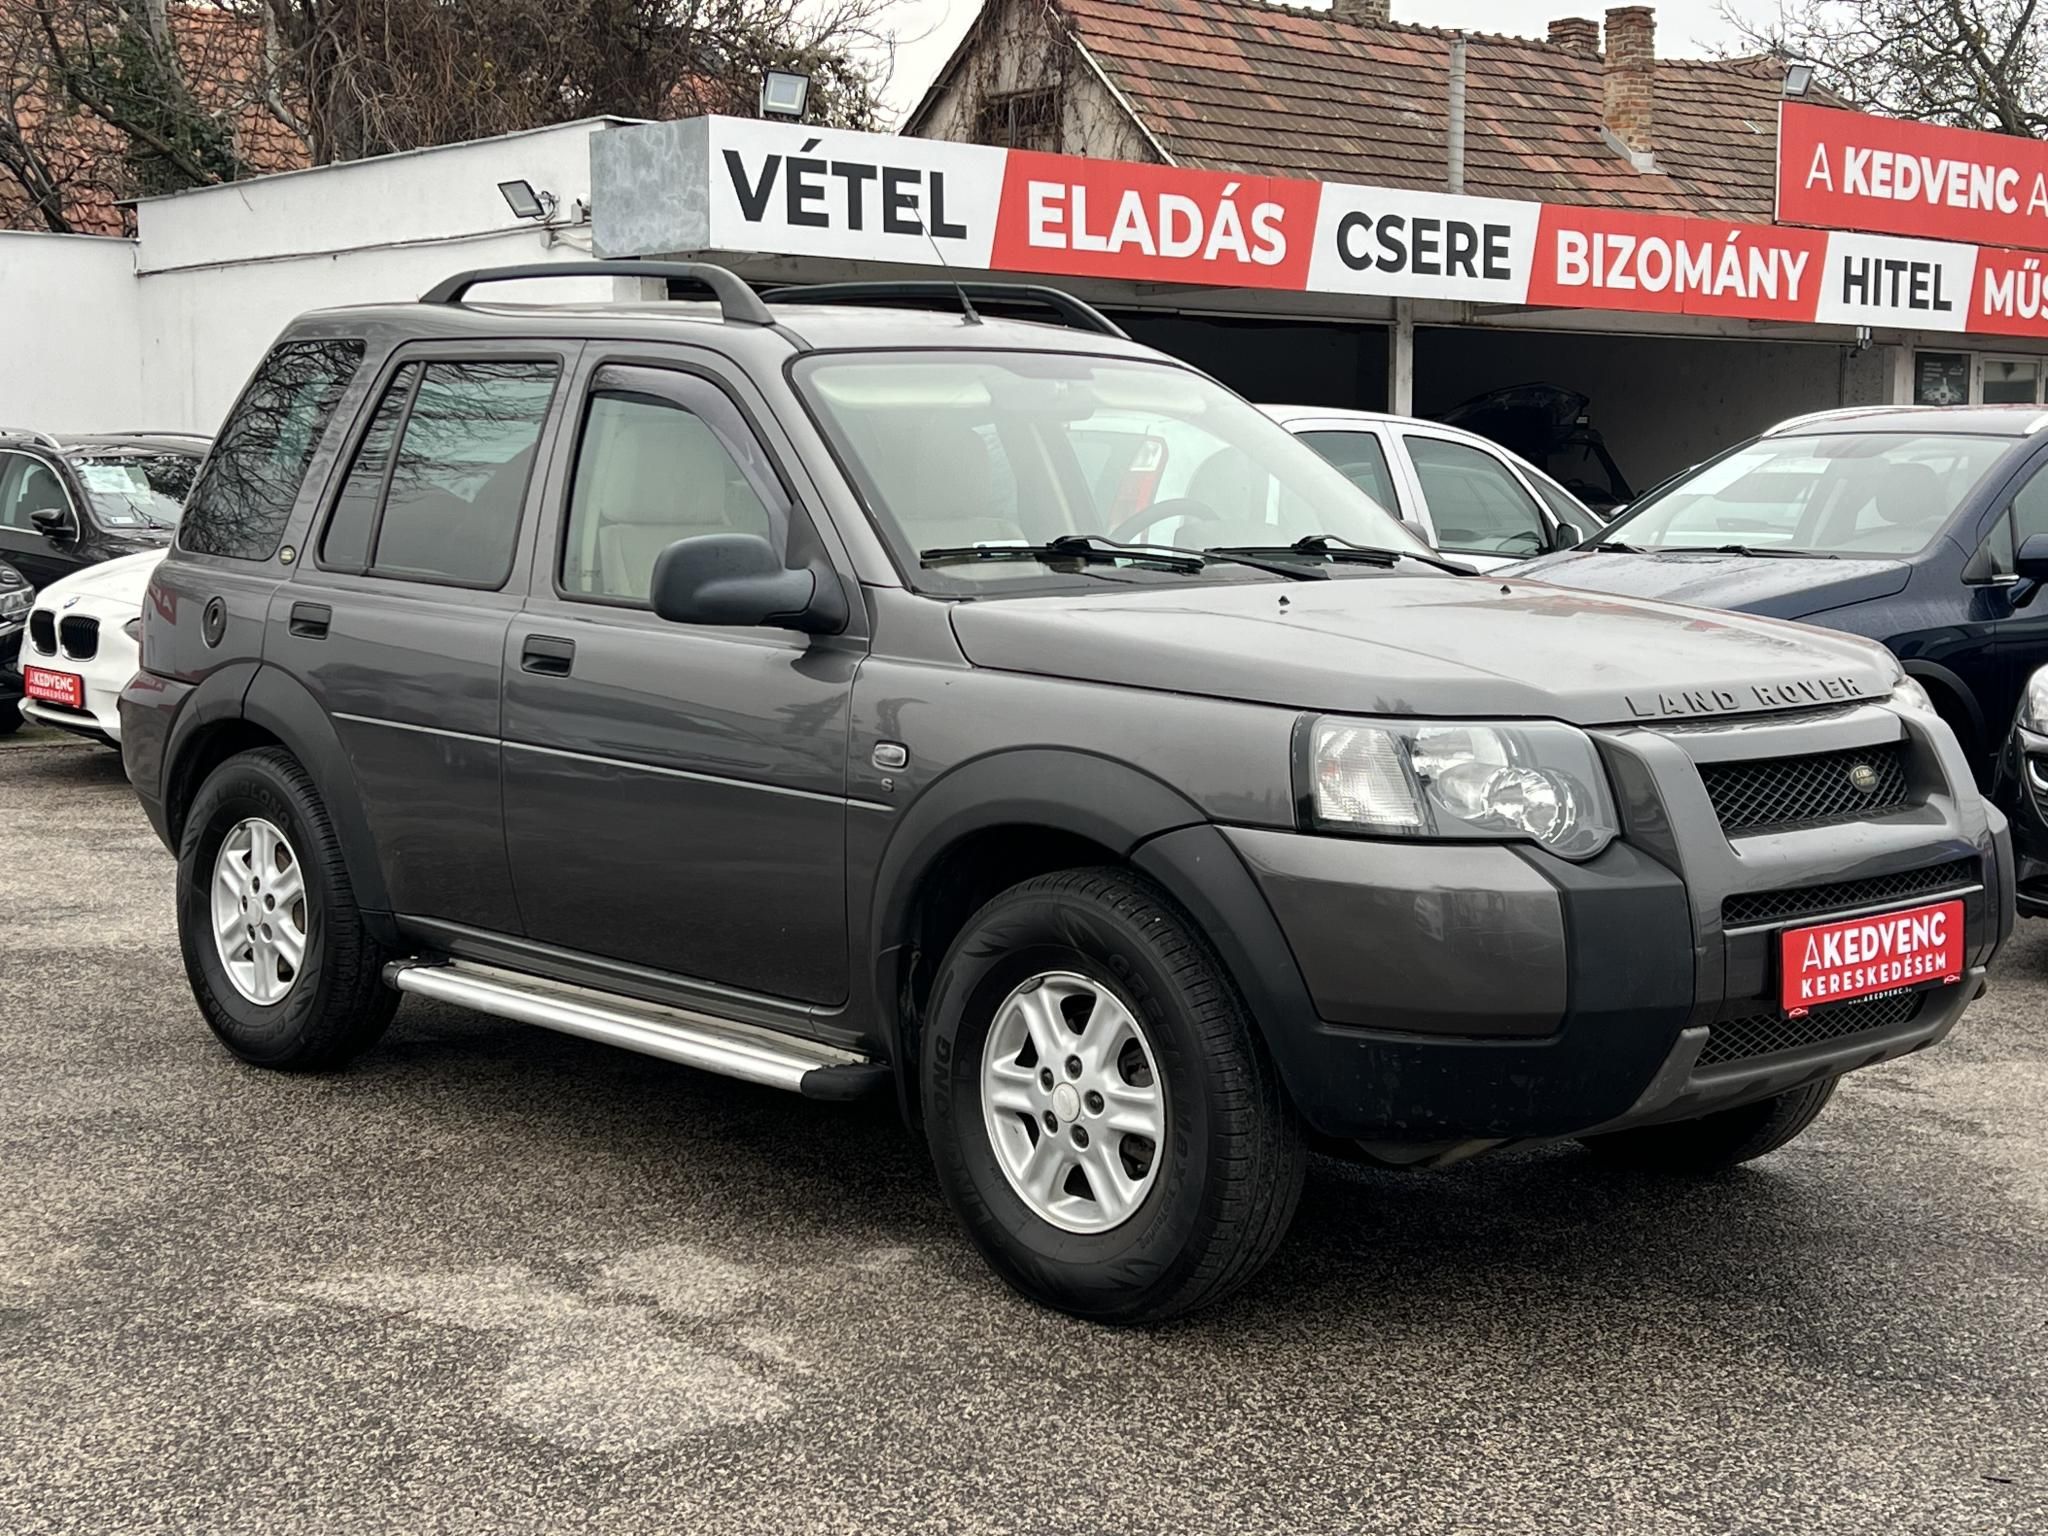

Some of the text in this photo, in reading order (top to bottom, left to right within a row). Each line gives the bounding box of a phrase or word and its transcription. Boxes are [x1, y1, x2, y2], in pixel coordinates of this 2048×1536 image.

[721, 138, 967, 240] VÉTEL
[1805, 142, 1833, 192] A
[1843, 146, 2020, 213] KEDVENC
[1027, 181, 1288, 266] ELADÁS
[1336, 210, 1512, 281] CSERE
[1556, 229, 1809, 302] BIZOMÁNY
[1842, 255, 1953, 312] HITEL
[1624, 676, 1865, 717] LAND ROVER
[880, 777, 895, 793] S
[1801, 911, 1947, 973] AKEDVENC
[1801, 951, 1947, 999] KERESKEDÉSEM
